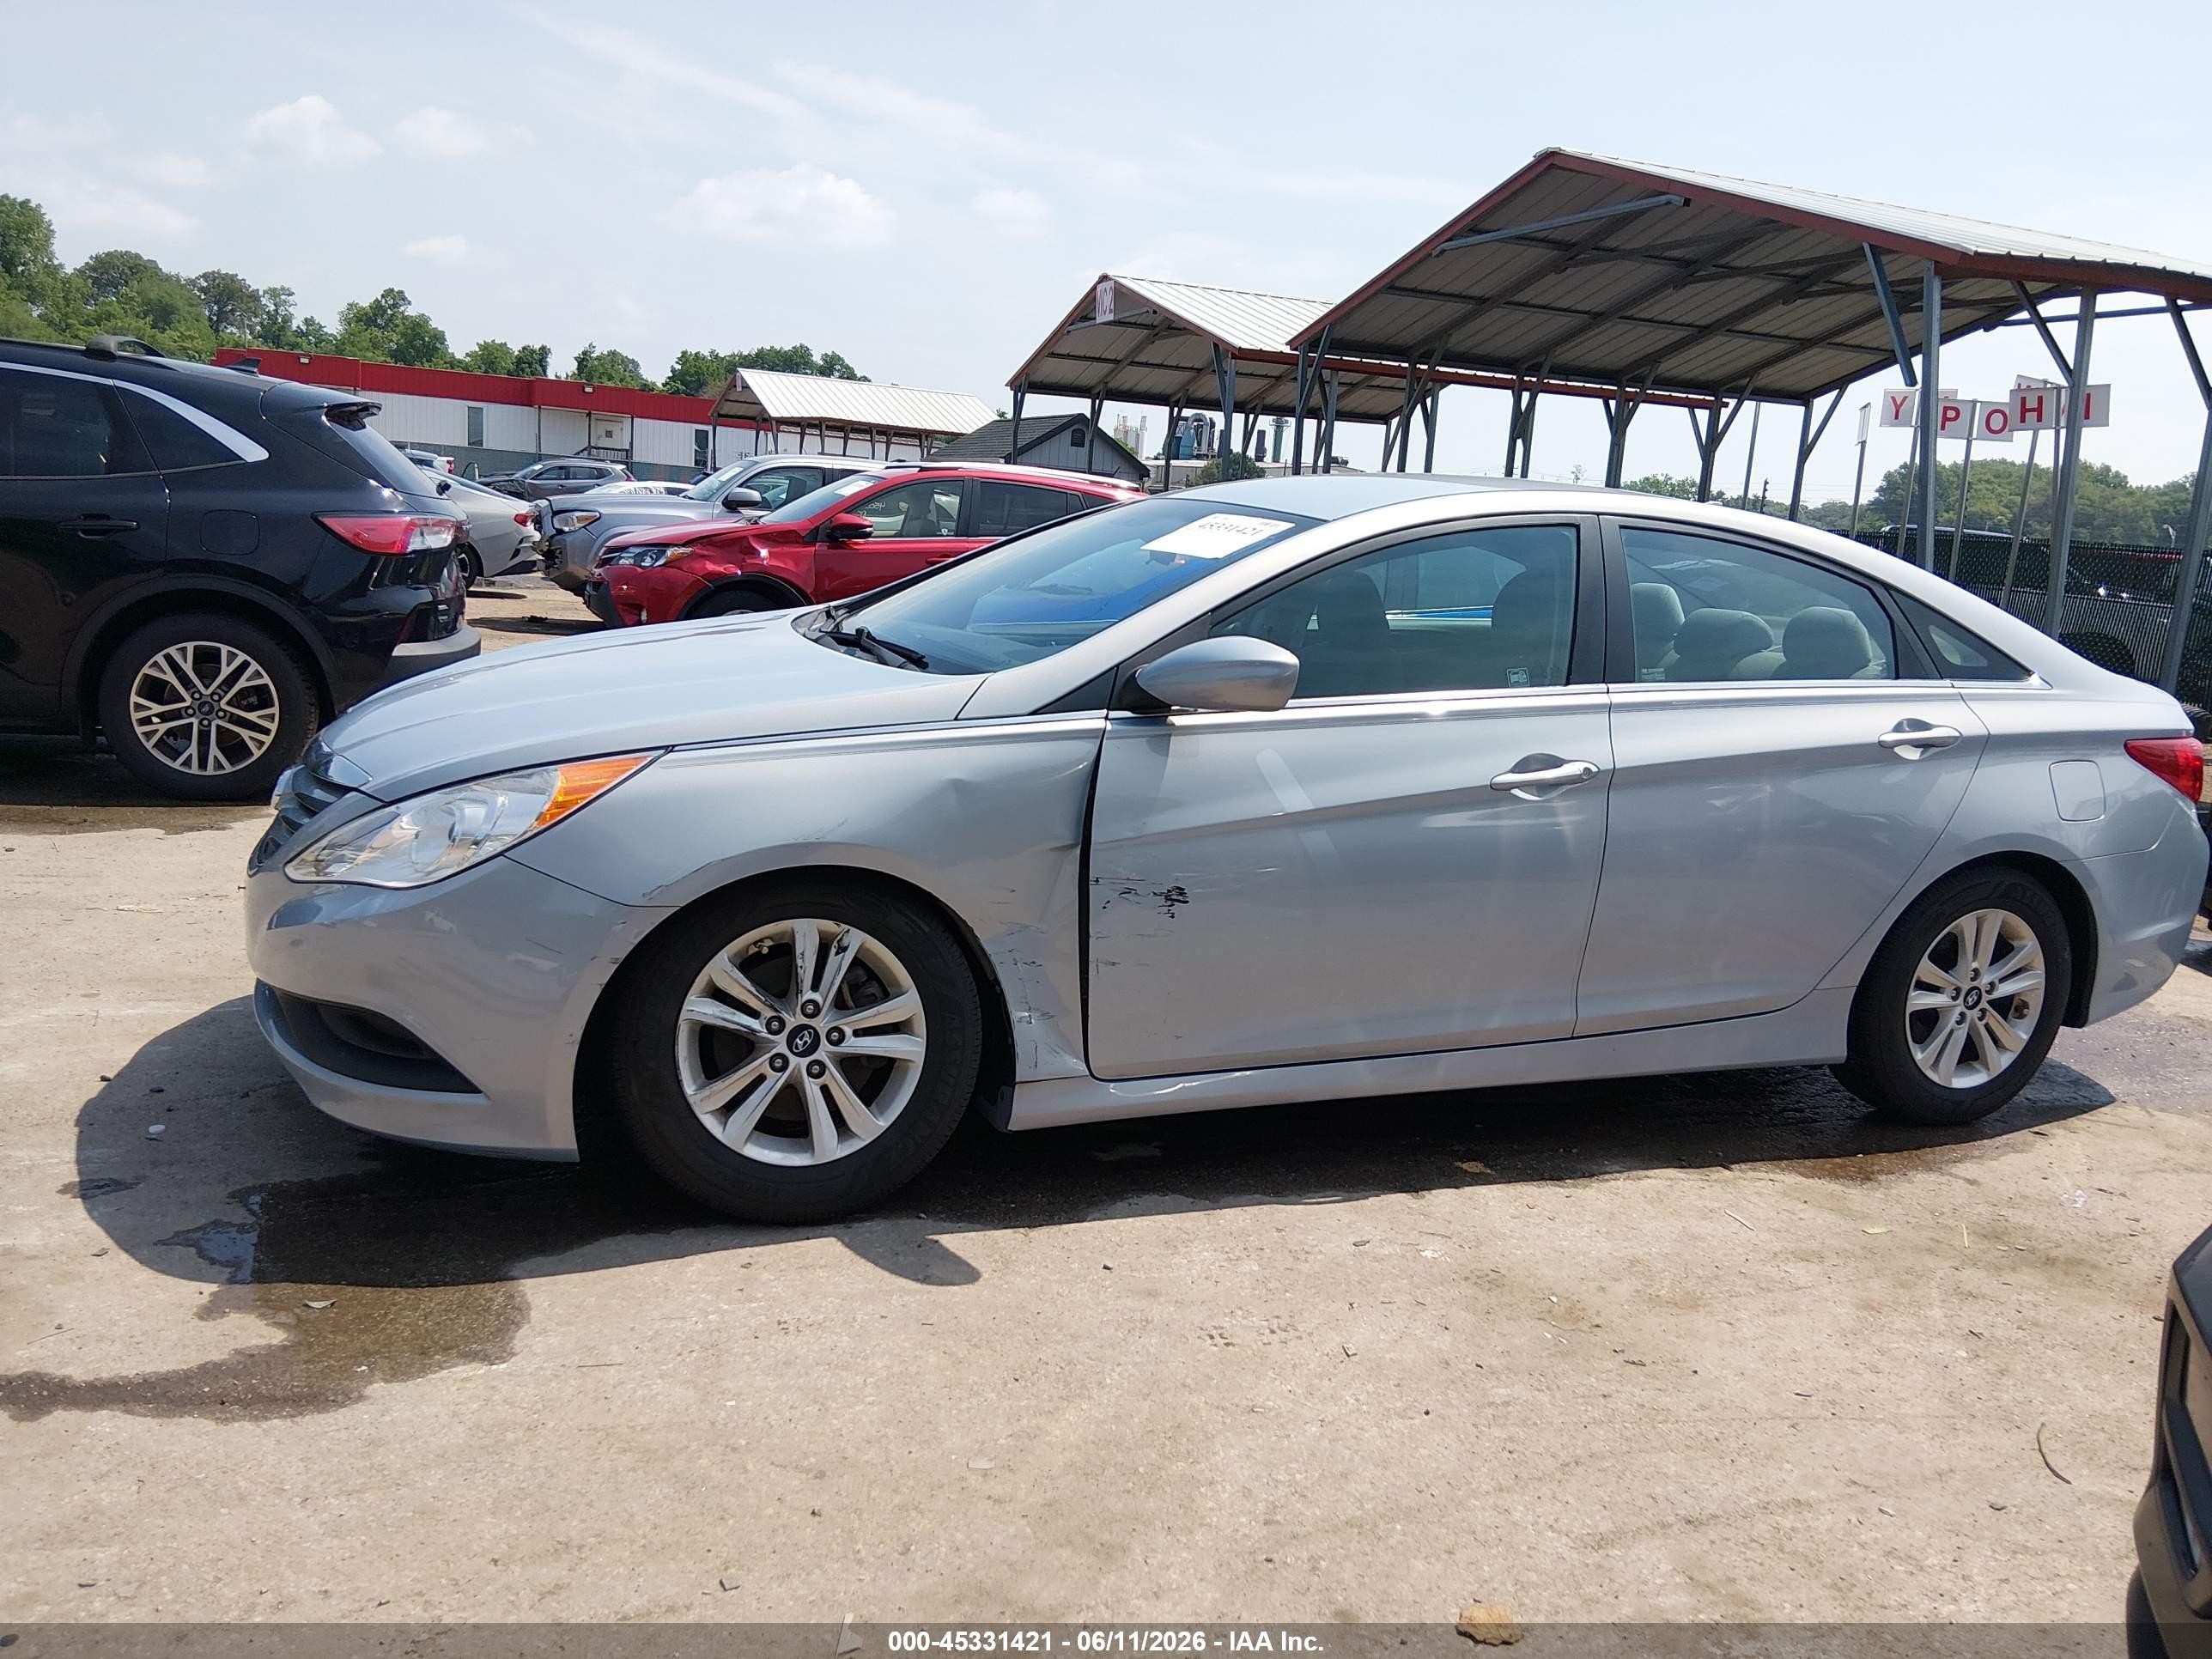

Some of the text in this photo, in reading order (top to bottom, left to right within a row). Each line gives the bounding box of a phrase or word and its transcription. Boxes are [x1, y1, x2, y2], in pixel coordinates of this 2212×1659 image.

[1891, 395, 1909, 421] Y
[1940, 405, 1961, 431] P
[2019, 395, 2044, 424] H
